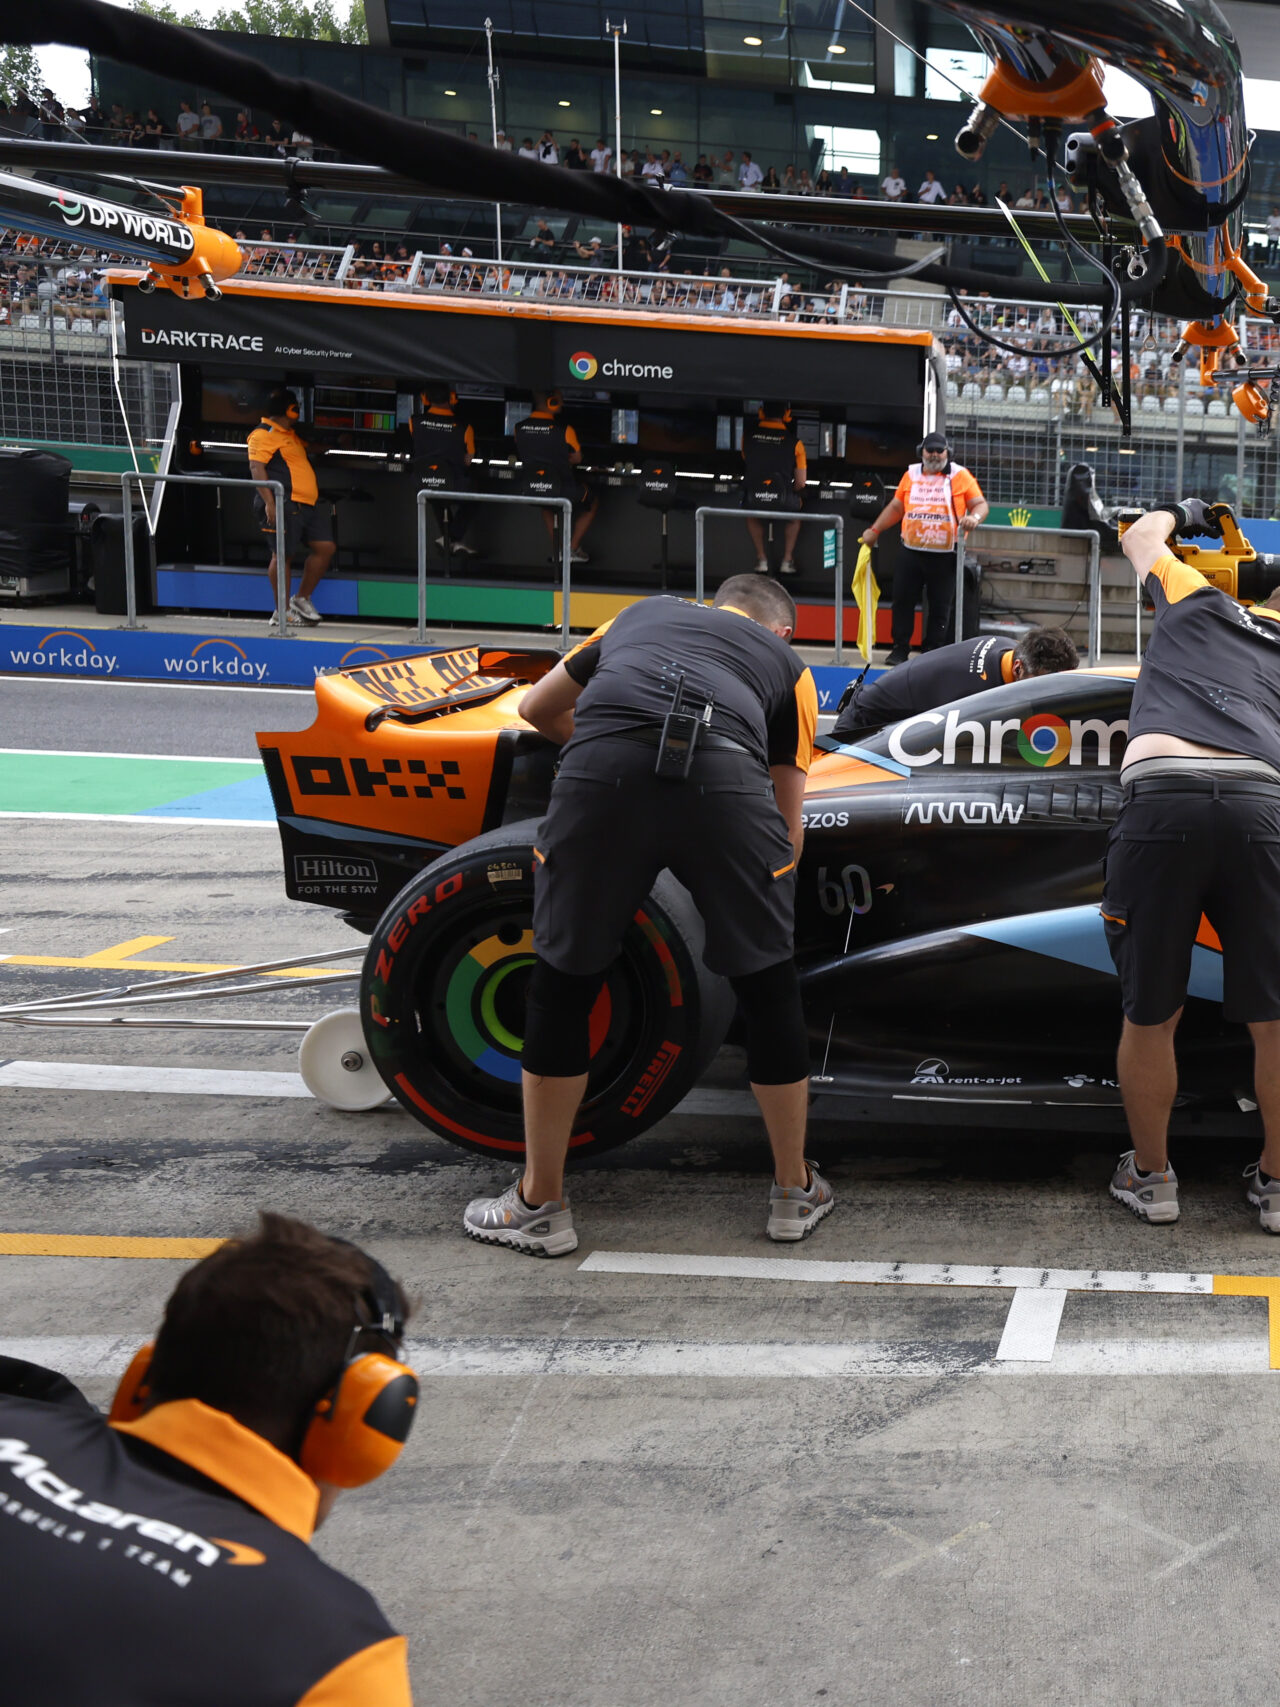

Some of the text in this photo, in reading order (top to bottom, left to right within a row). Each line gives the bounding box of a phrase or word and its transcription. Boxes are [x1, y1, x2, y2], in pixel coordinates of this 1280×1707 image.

[86, 202, 194, 251] DP WORLD
[141, 328, 264, 352] DARKTRACE
[283, 347, 302, 356] Cyber
[302, 348, 329, 358] Security
[329, 350, 353, 359] Partner
[602, 359, 674, 379] chrome
[290, 755, 467, 800] OKX
[801, 811, 850, 829] ezos
[905, 802, 1025, 825] ARROW
[302, 860, 371, 878] Hilton
[298, 885, 378, 894] FOR THE STAY
[817, 864, 873, 916] 60
[374, 872, 464, 985] ZERO
[619, 1040, 683, 1119] PIRELLI
[947, 1076, 1023, 1085] rent-a-jet
[0, 1438, 221, 1567] McLaren
[123, 1544, 193, 1588] TEAM
